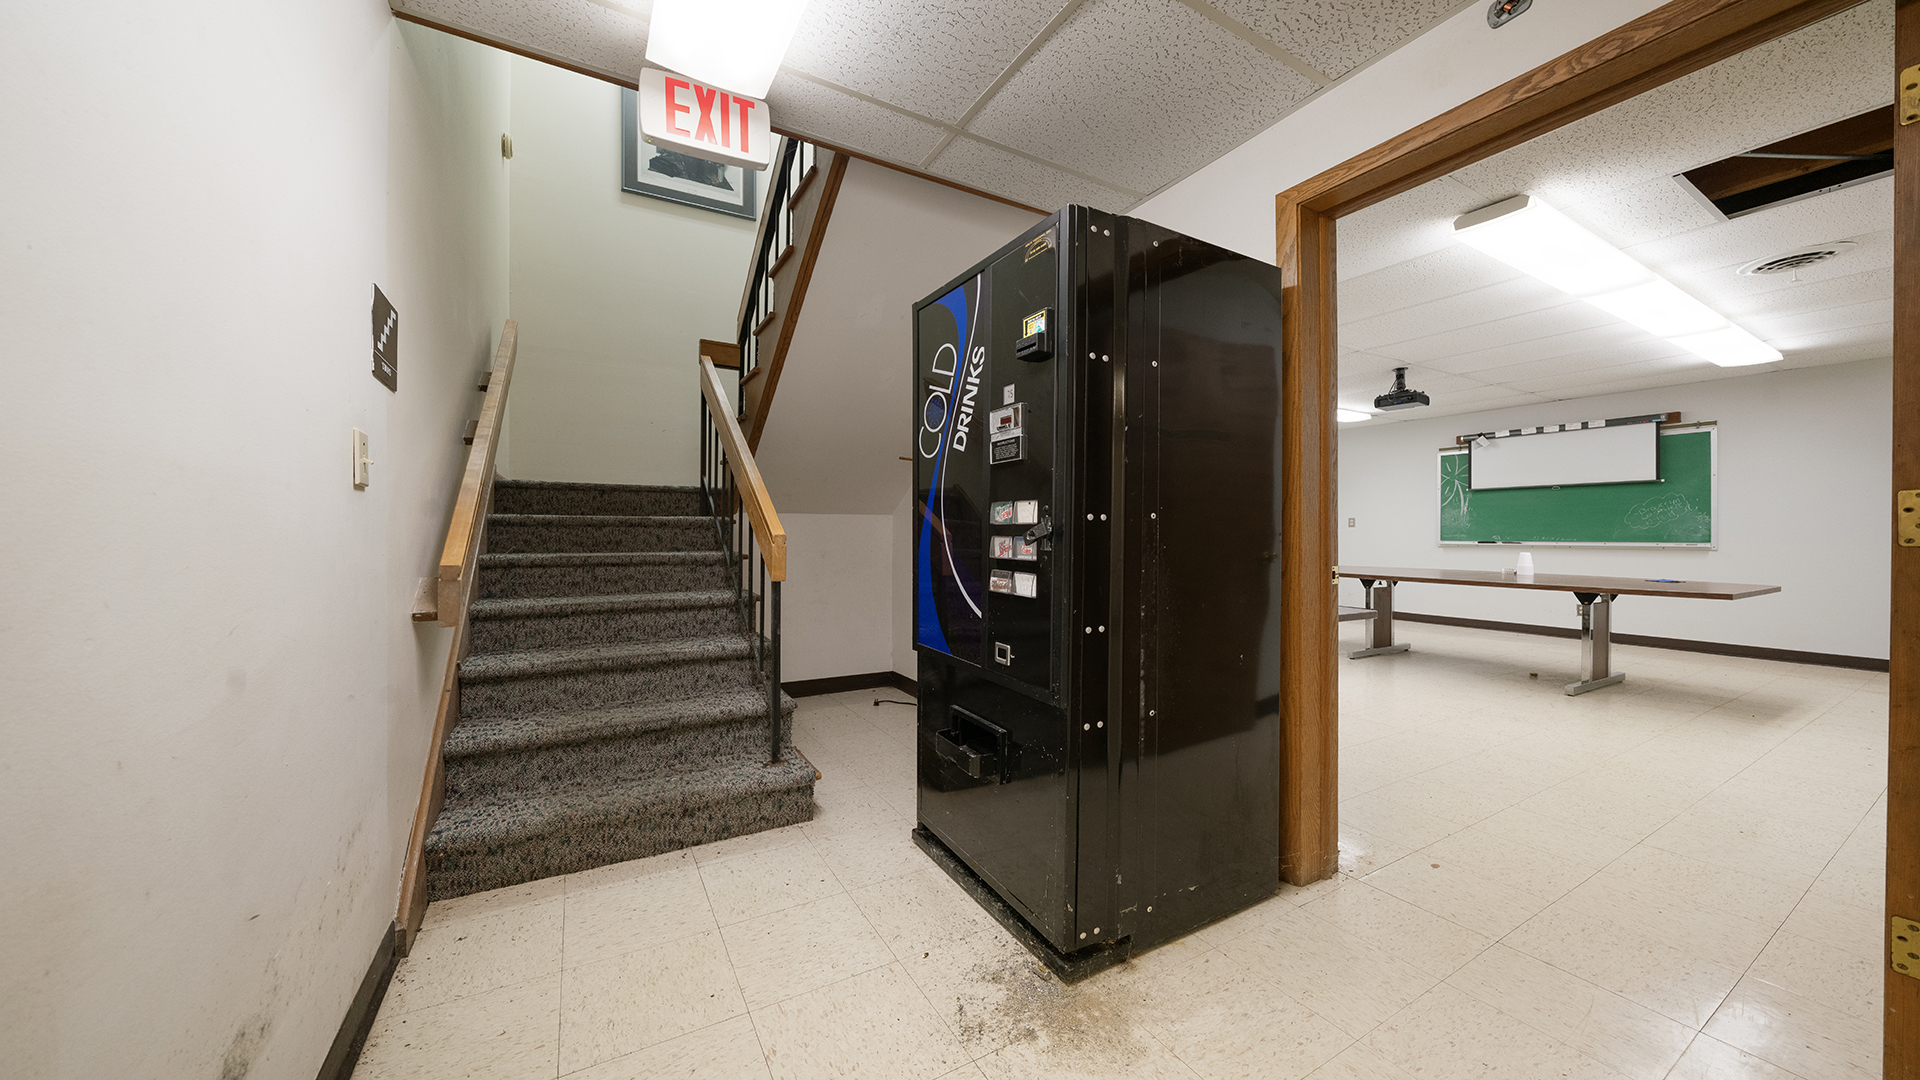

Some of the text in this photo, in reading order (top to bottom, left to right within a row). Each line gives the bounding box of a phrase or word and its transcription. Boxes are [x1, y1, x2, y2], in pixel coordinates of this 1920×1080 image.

[664, 76, 755, 154] EXIT
[918, 342, 958, 459] COLD
[952, 345, 985, 452] DRINKS
